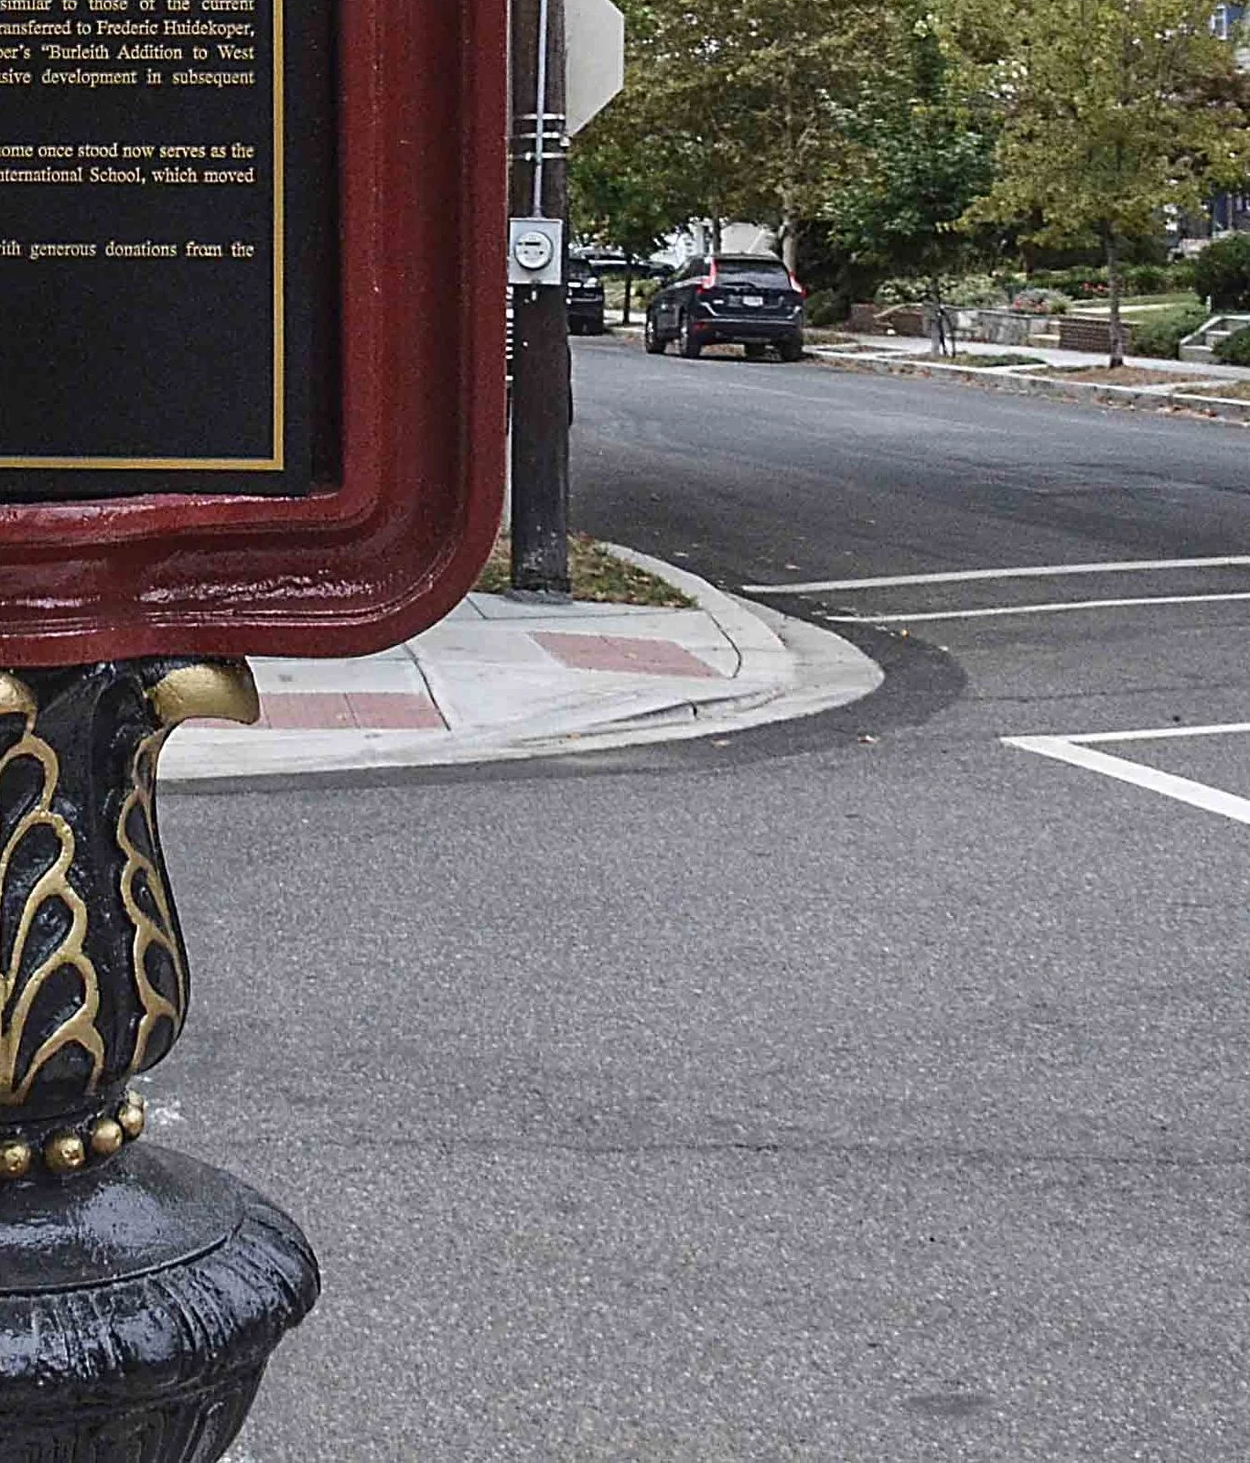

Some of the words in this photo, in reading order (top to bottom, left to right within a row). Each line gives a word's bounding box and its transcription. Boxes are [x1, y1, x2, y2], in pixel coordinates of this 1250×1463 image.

[77, 22, 91, 35] to
[97, 19, 158, 35] Frederic
[163, 19, 254, 39] Huidekoper,
[90, 167, 145, 184] School,
[152, 167, 198, 182] which
[204, 167, 254, 183] moved
[30, 244, 96, 259] generous
[106, 241, 177, 257] donations
[186, 241, 222, 257] from
[231, 242, 254, 257] the
